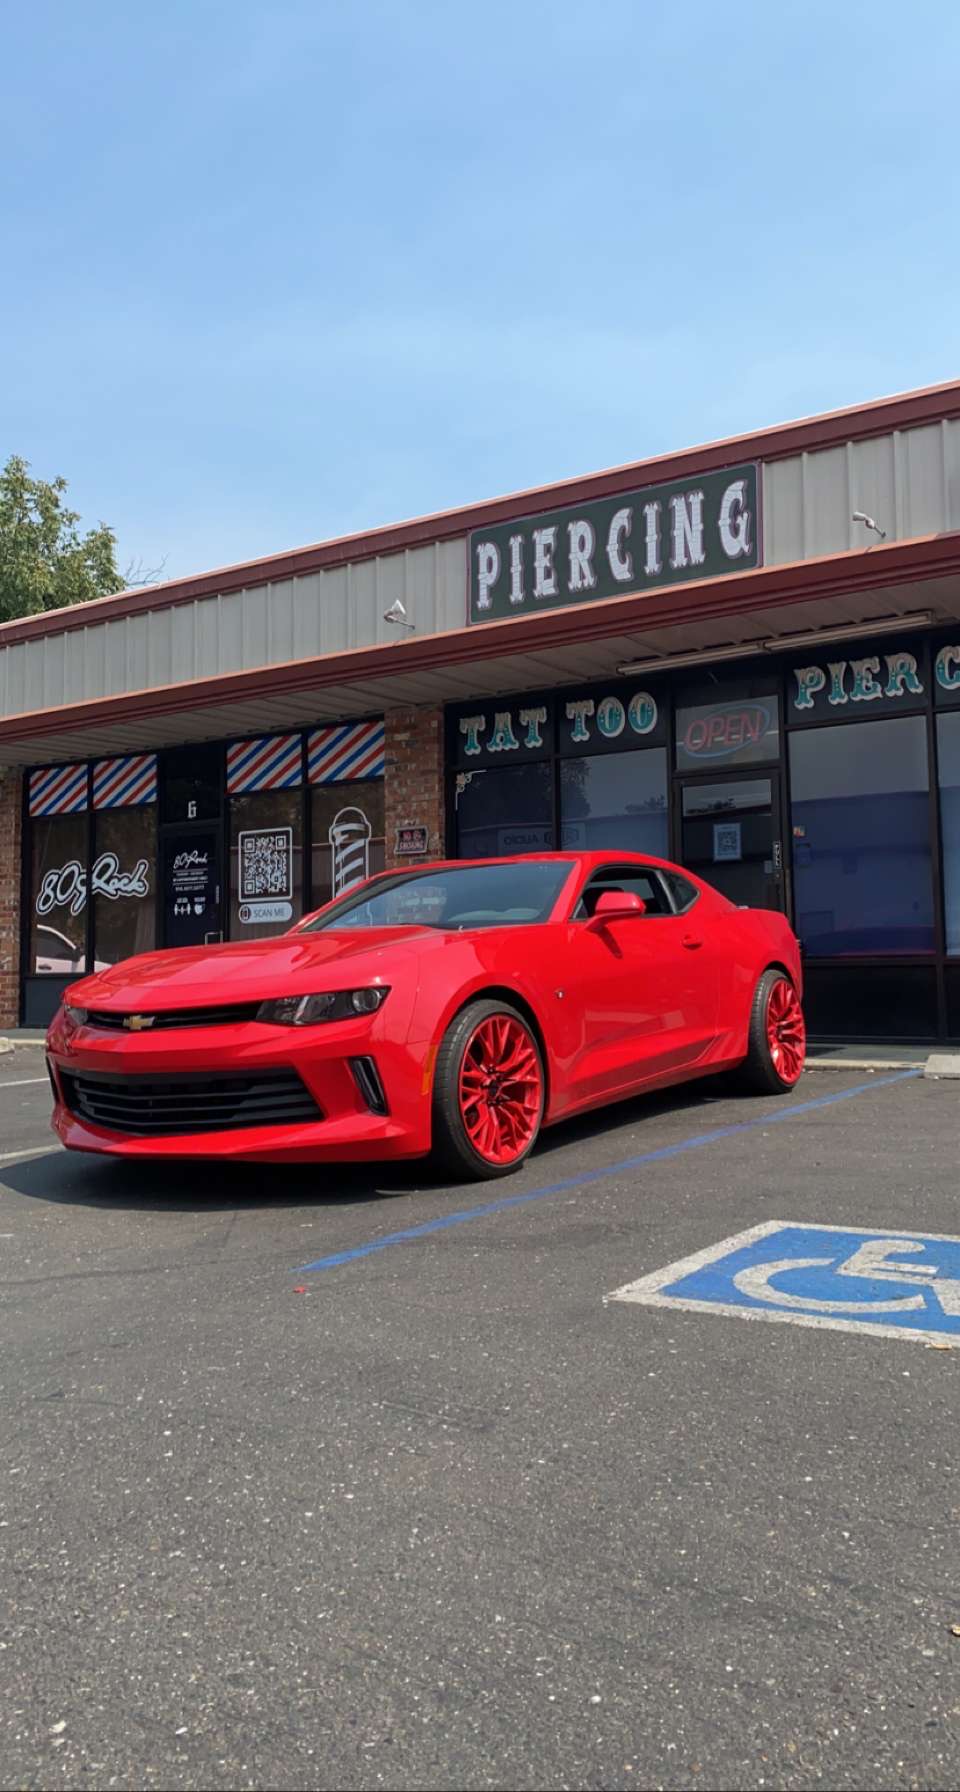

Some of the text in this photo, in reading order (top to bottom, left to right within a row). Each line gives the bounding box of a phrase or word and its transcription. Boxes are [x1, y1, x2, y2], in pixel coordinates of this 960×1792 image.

[476, 479, 752, 610] PIERCING
[684, 709, 765, 752] OPEN
[253, 907, 285, 918] SCAN ME
